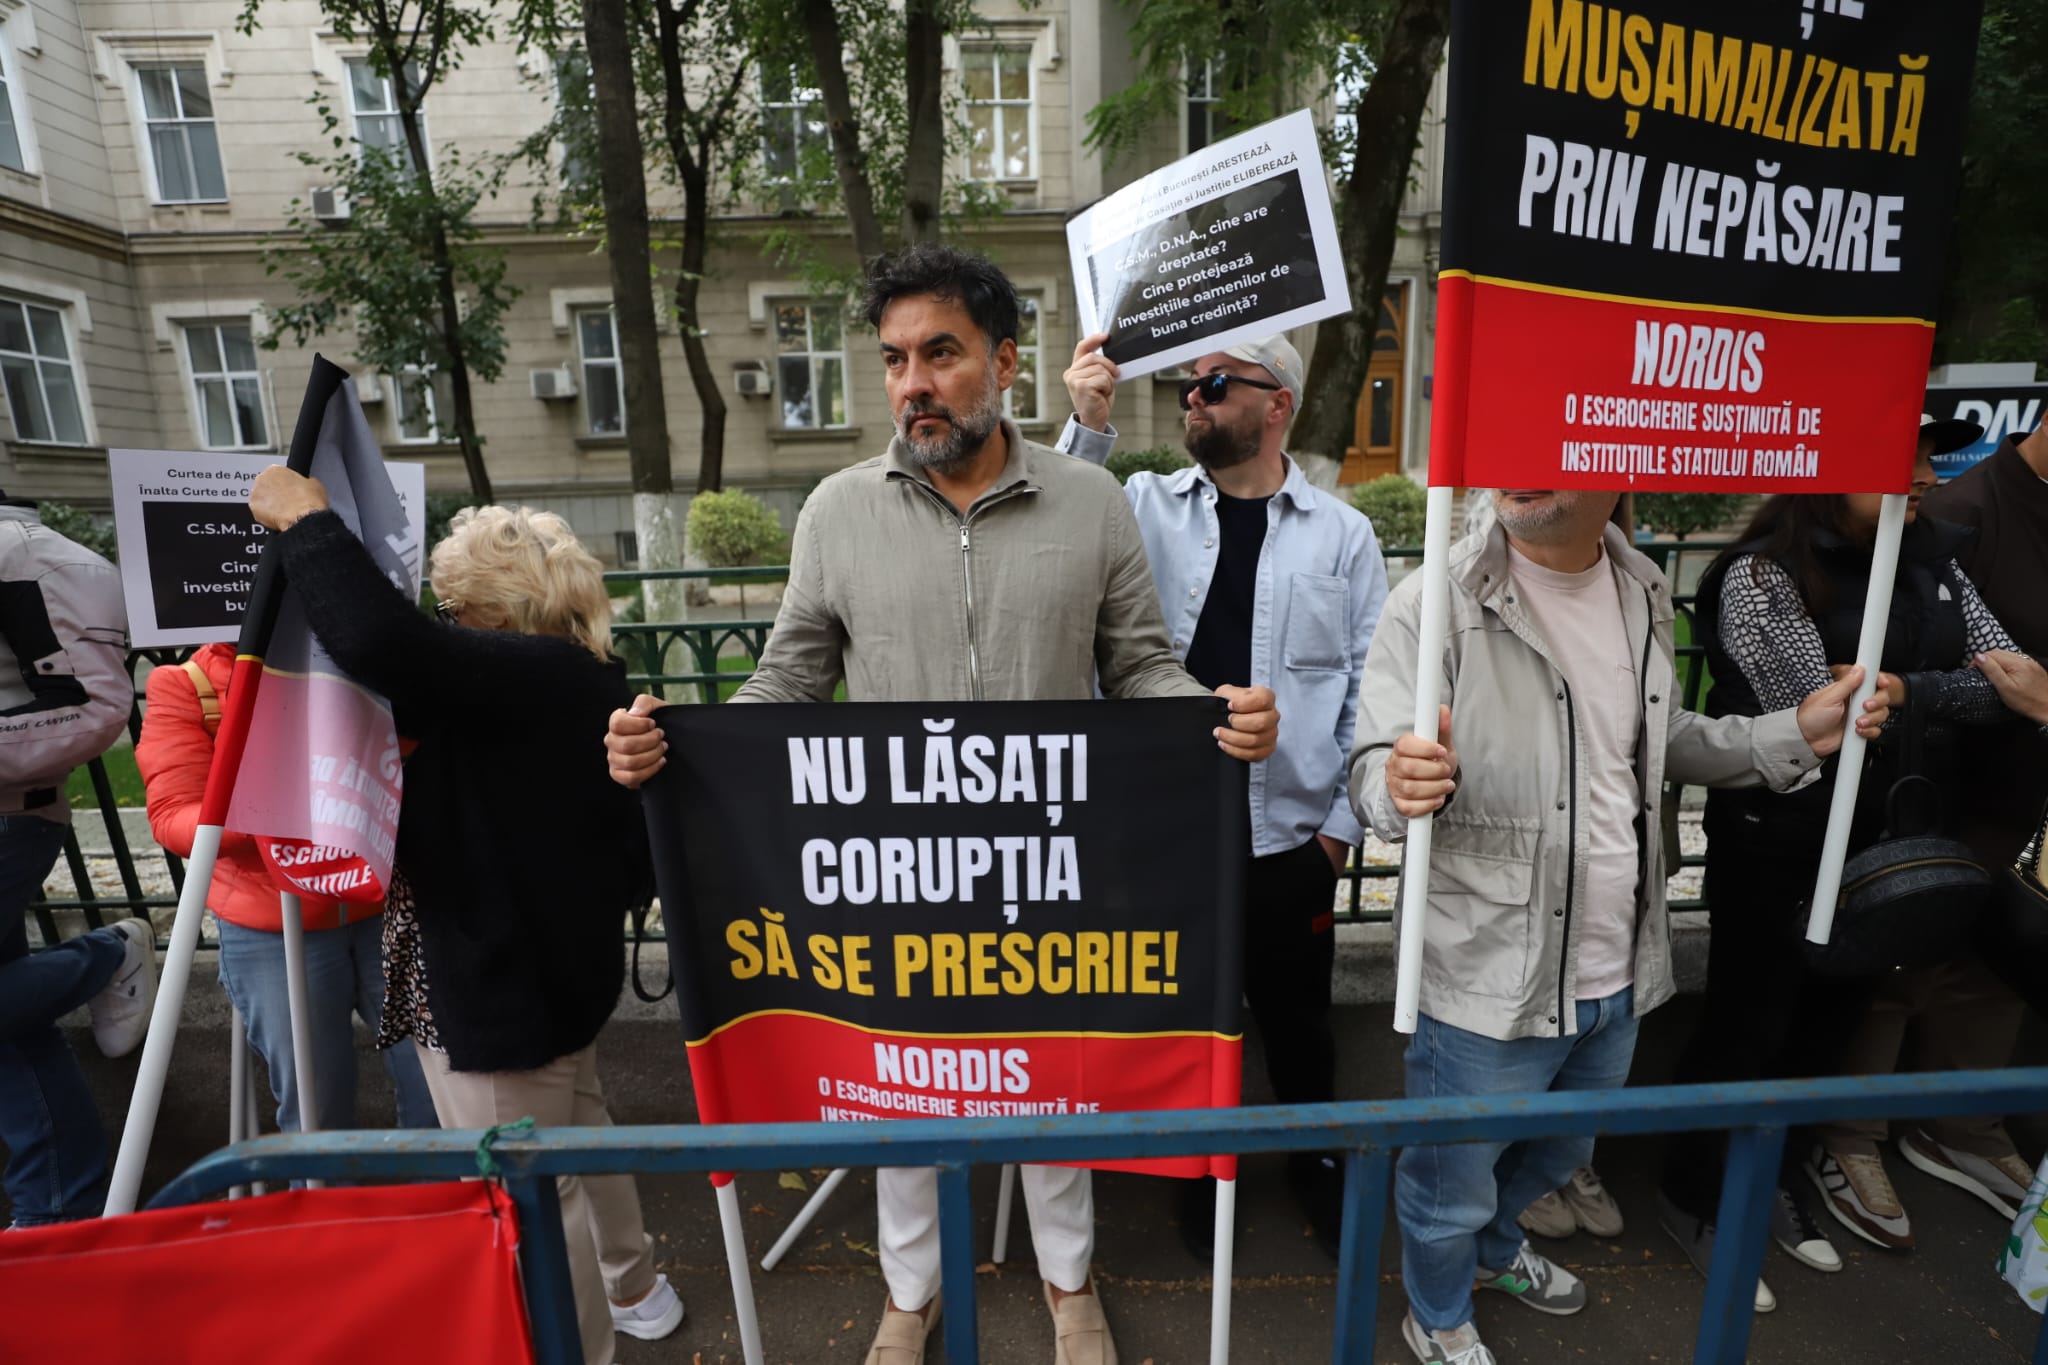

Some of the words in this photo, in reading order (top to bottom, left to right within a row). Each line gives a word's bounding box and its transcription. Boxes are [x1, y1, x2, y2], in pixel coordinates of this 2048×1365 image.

[1523, 0, 1929, 156] MUȘAMALIZATĂ
[1211, 142, 1272, 174] ARESTEAZĂ
[1232, 151, 1298, 184] ELIBEREAZĂ
[1518, 134, 1647, 245] PRIN
[1653, 159, 1904, 272] NEPĂSARE
[1159, 230, 1207, 254] D.N.A.,
[1209, 215, 1241, 235] cine
[1243, 206, 1268, 223] are
[1142, 281, 1174, 300] Cine
[1177, 252, 1254, 291] protejează
[1158, 240, 1227, 274] dreptate?
[1118, 296, 1190, 329] investițiile
[1193, 271, 1266, 304] oamenilor
[1270, 263, 1290, 279] de
[1151, 319, 1188, 338] buna
[1190, 294, 1258, 326] credință?
[1631, 320, 1765, 393] NORDIS
[1565, 393, 1577, 425] O
[1582, 394, 1698, 432] ESCROCHERIE
[1702, 401, 1792, 442] SUSȚINUTĂ
[1797, 407, 1822, 436] DE
[1952, 399, 2041, 444] DN
[167, 468, 212, 480] Curtea
[215, 469, 231, 480] de
[233, 470, 260, 481] Ape
[1561, 440, 1666, 484] INSTITUȚIILE
[1671, 446, 1748, 477] STATULUI
[1752, 443, 1818, 478] ROMÂN
[139, 484, 179, 496] Înalta
[182, 486, 219, 497] Curte
[221, 486, 238, 497] de
[187, 523, 247, 537] C.S.M.,
[787, 736, 867, 804] NU
[888, 718, 1088, 826] LĂSAȚI
[801, 836, 1081, 924] CORUPȚIA
[725, 907, 799, 980] SĂ
[808, 934, 875, 996] SE
[894, 931, 1179, 997] PRESCRIE!
[873, 1042, 1030, 1094] NORDIS
[818, 1076, 831, 1097] O
[836, 1079, 957, 1117] ESCROCHERIE
